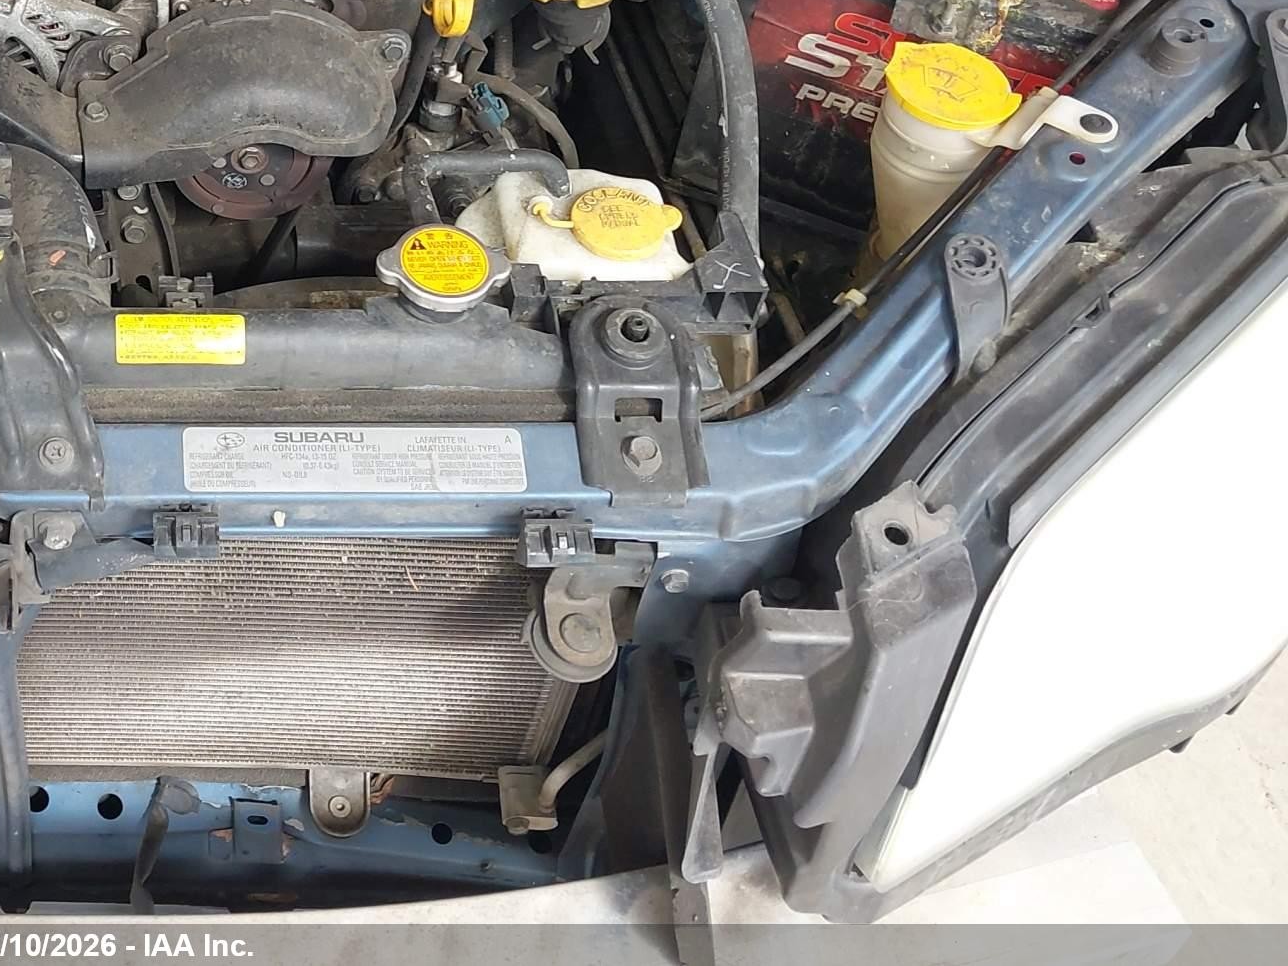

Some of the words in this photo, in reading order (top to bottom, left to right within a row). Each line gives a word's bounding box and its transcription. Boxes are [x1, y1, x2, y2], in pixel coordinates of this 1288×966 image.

[795, 83, 881, 124] PRE
[427, 240, 469, 249] WARNING
[274, 431, 365, 444] SUBARU
[415, 436, 455, 444] LAFAYETTE
[504, 435, 512, 444] A
[253, 444, 271, 453] AIR
[272, 444, 337, 453] CONDITIONER
[338, 444, 381, 453] (LI-TYPE)
[407, 444, 463, 453] CLIMATISEUR
[464, 444, 502, 453] (LI-TYPE)
